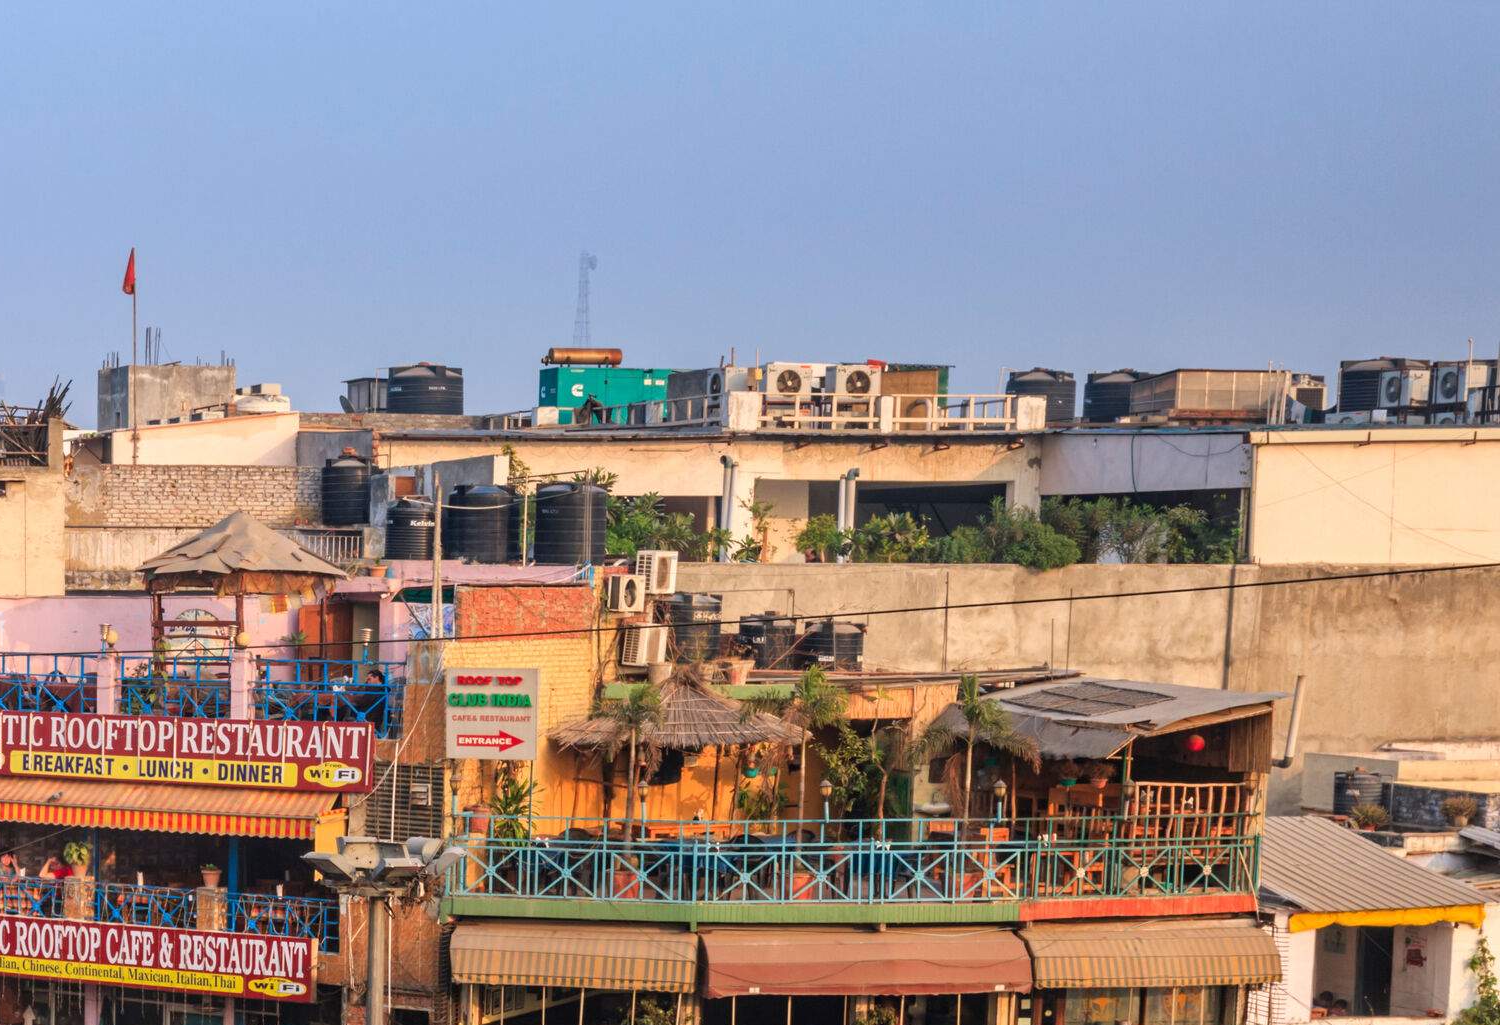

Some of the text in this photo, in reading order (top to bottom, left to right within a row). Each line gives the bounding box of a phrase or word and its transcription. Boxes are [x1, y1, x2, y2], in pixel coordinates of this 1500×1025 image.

[457, 676, 523, 685] ROOF TOP
[449, 693, 532, 707] CLUB INDIA
[49, 716, 175, 753] ROOFTOP
[181, 719, 366, 761] RESTAURANT
[459, 737, 512, 745] ENTRANCE
[22, 753, 283, 784] BREAKFAST LUNCH DINNER
[15, 920, 100, 963] ROOFTOP
[105, 926, 155, 967] CAFE
[159, 934, 174, 968] &
[178, 934, 308, 979] RESTAURANT
[22, 957, 62, 976] Chinese,
[65, 962, 125, 980] Continental,
[127, 966, 174, 985] Maxican,
